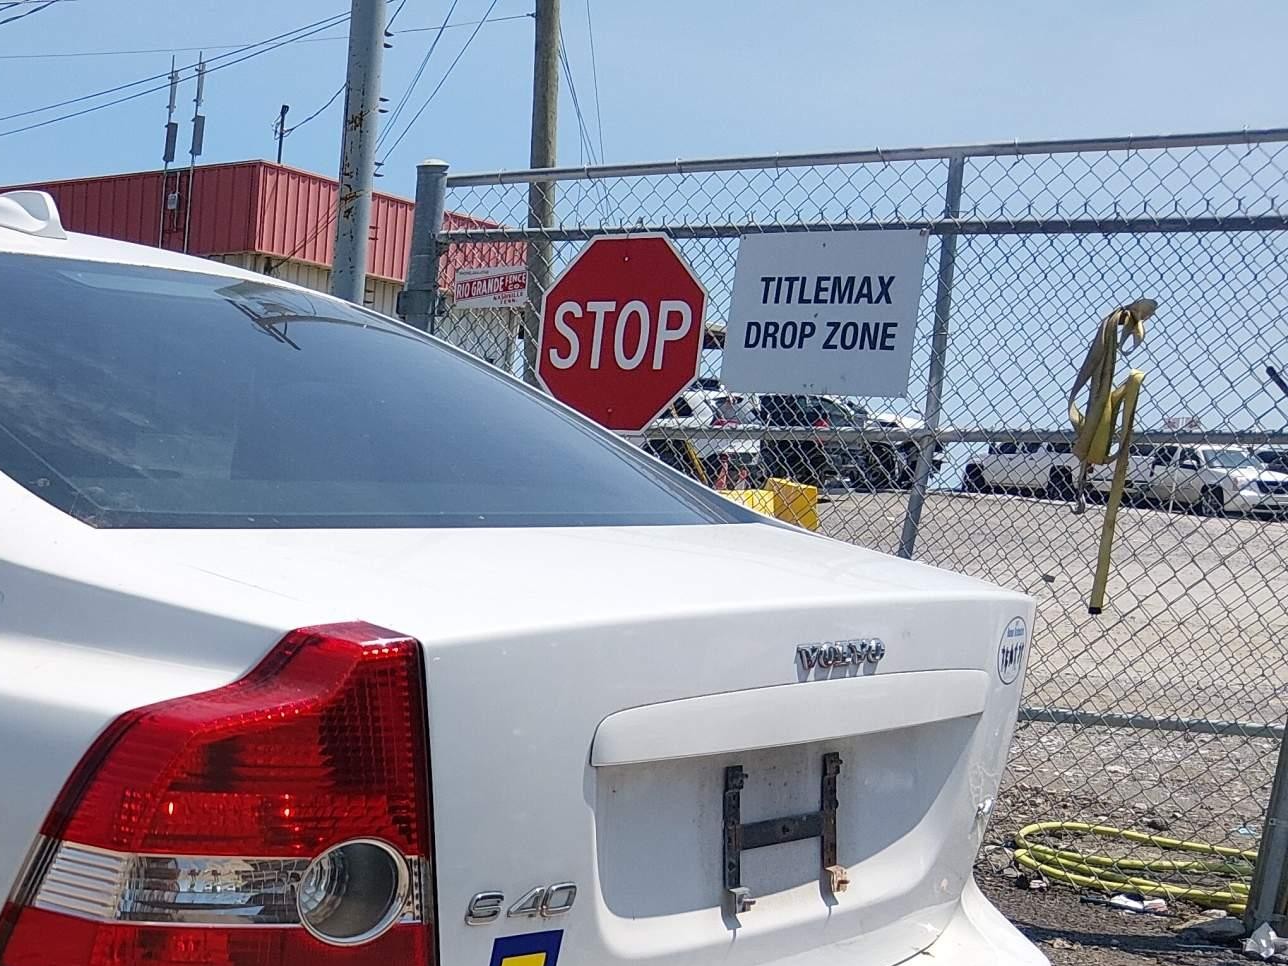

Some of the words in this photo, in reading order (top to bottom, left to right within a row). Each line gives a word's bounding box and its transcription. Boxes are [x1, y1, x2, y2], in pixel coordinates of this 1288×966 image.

[456, 283, 471, 299] RIO
[471, 277, 505, 297] GRANDE
[504, 273, 526, 287] FENCE
[760, 276, 896, 305] TITLEMAX
[549, 300, 692, 370] STOP
[744, 321, 816, 350] DROP
[822, 321, 898, 350] ZONE
[796, 639, 885, 670] VOLVO
